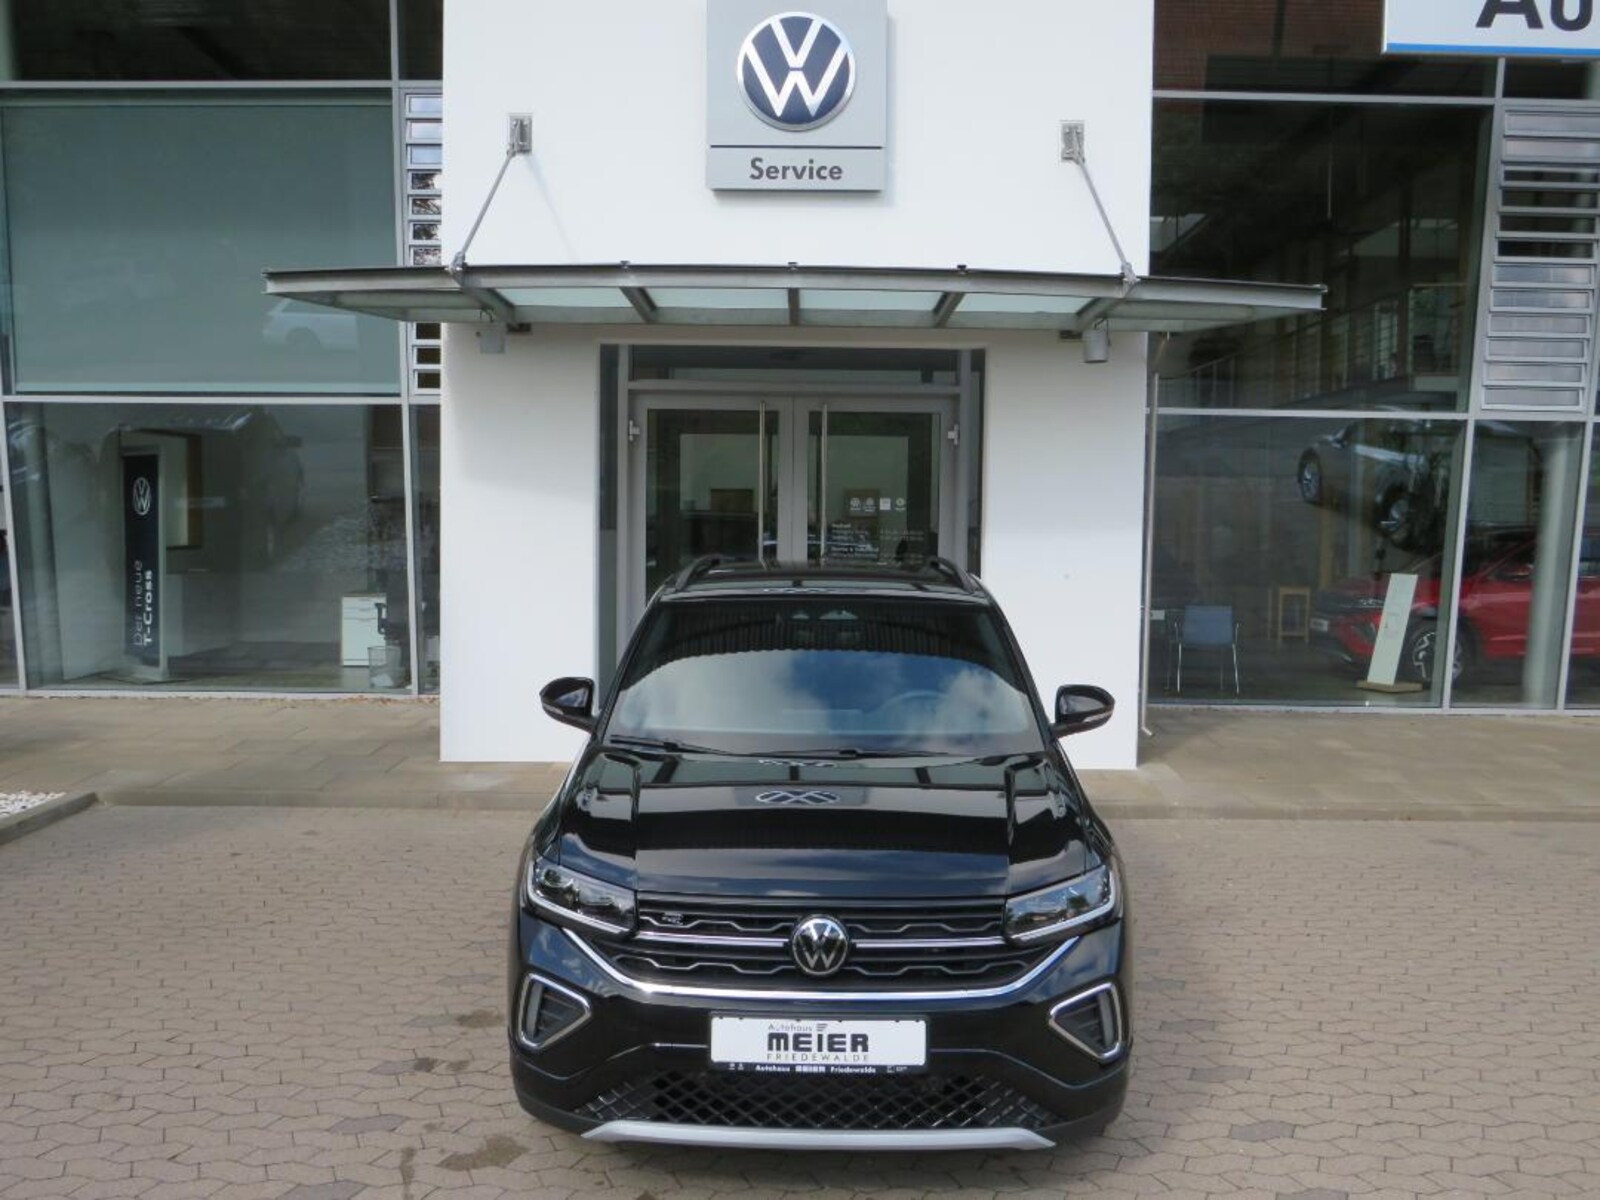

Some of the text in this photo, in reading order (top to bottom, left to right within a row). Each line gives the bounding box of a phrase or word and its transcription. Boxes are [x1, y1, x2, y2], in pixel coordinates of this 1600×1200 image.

[749, 156, 844, 181] Service
[143, 569, 153, 647] T-Cross
[766, 1053, 869, 1062] FRIEDEWALDE
